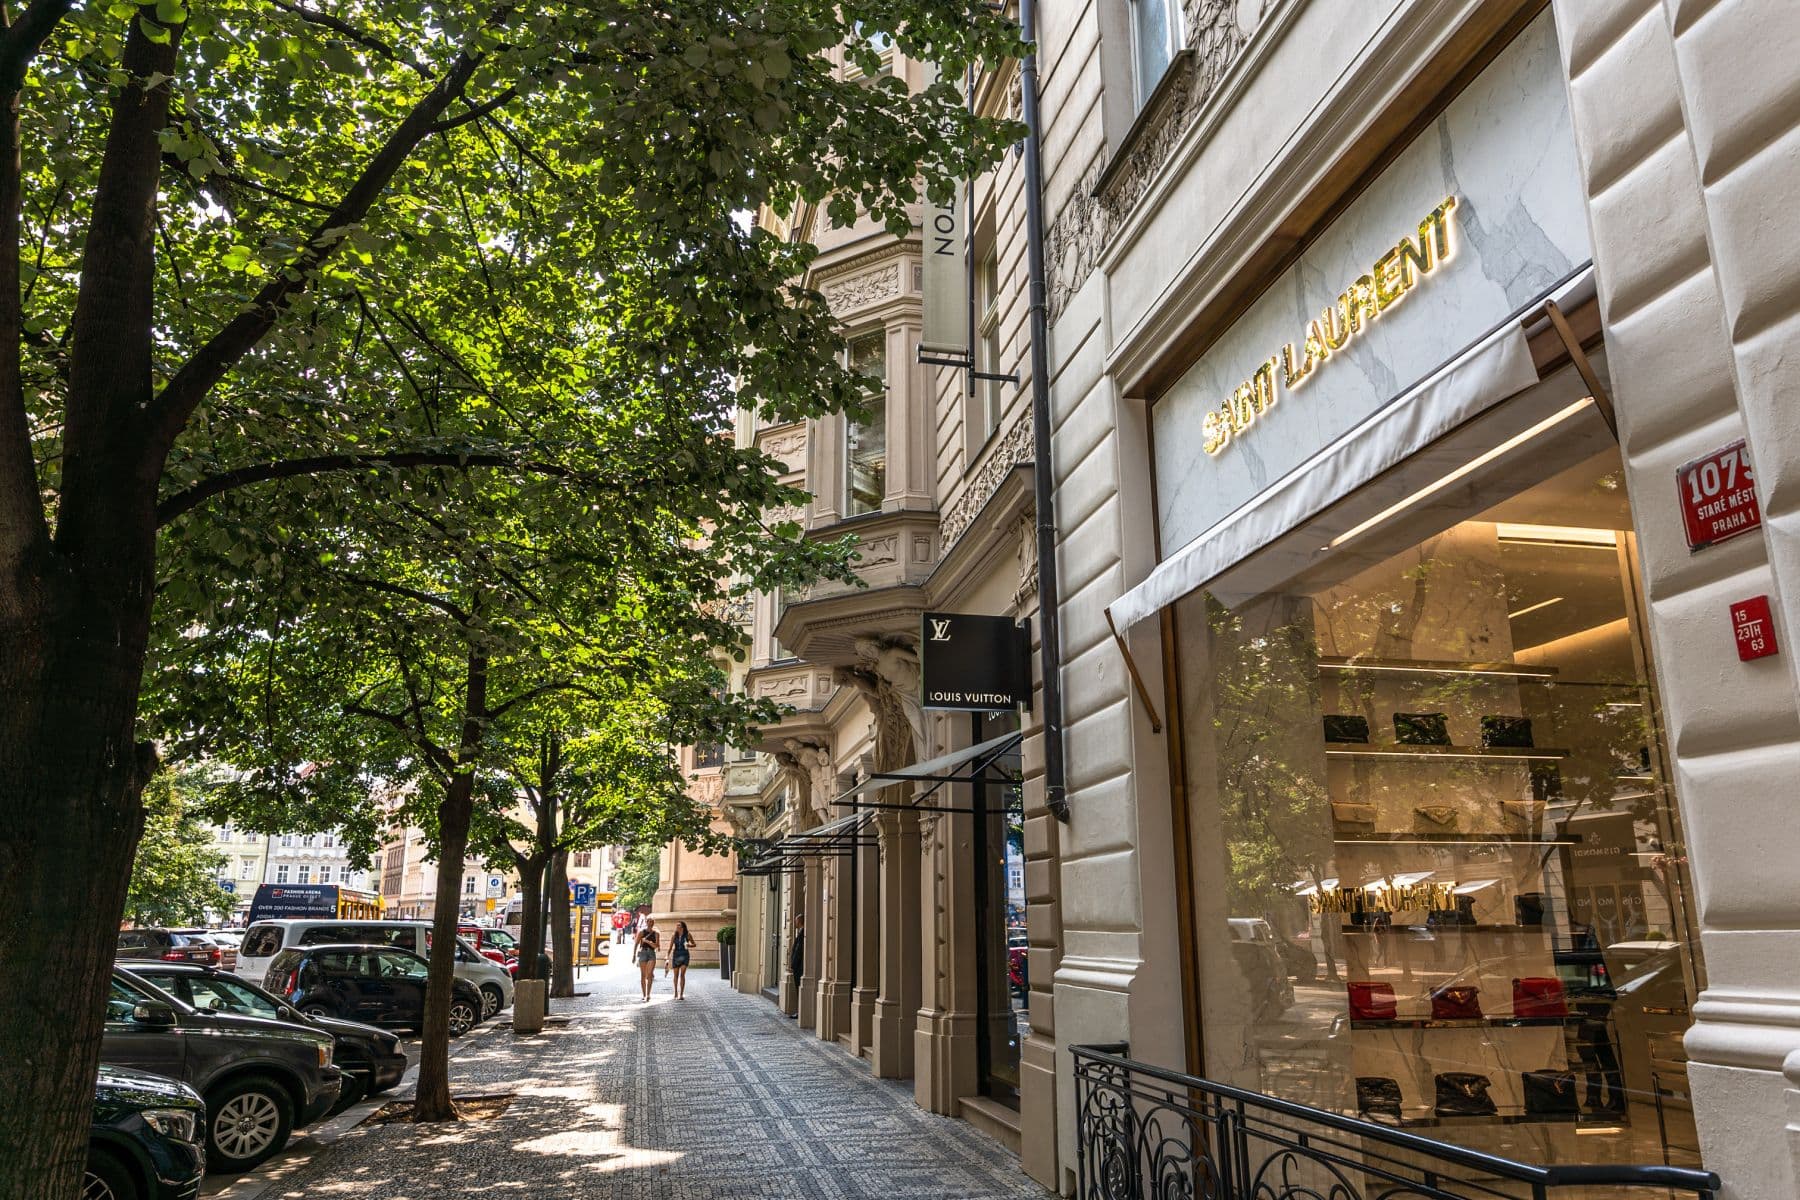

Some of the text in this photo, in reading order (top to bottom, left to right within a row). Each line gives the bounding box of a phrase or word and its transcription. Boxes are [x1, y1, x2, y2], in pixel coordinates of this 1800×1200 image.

[1203, 196, 1456, 453] SAINT LAURENT
[1698, 488, 1754, 520] STARÉ MĚST
[1712, 508, 1754, 534] PRAHA 1
[1735, 610, 1747, 622] 15
[1737, 624, 1761, 640] 23 H
[1751, 638, 1764, 651] 63
[930, 692, 1011, 704] LOUIS VUITTON
[577, 886, 587, 899] P
[1309, 880, 1456, 913] SAINT LAURENT
